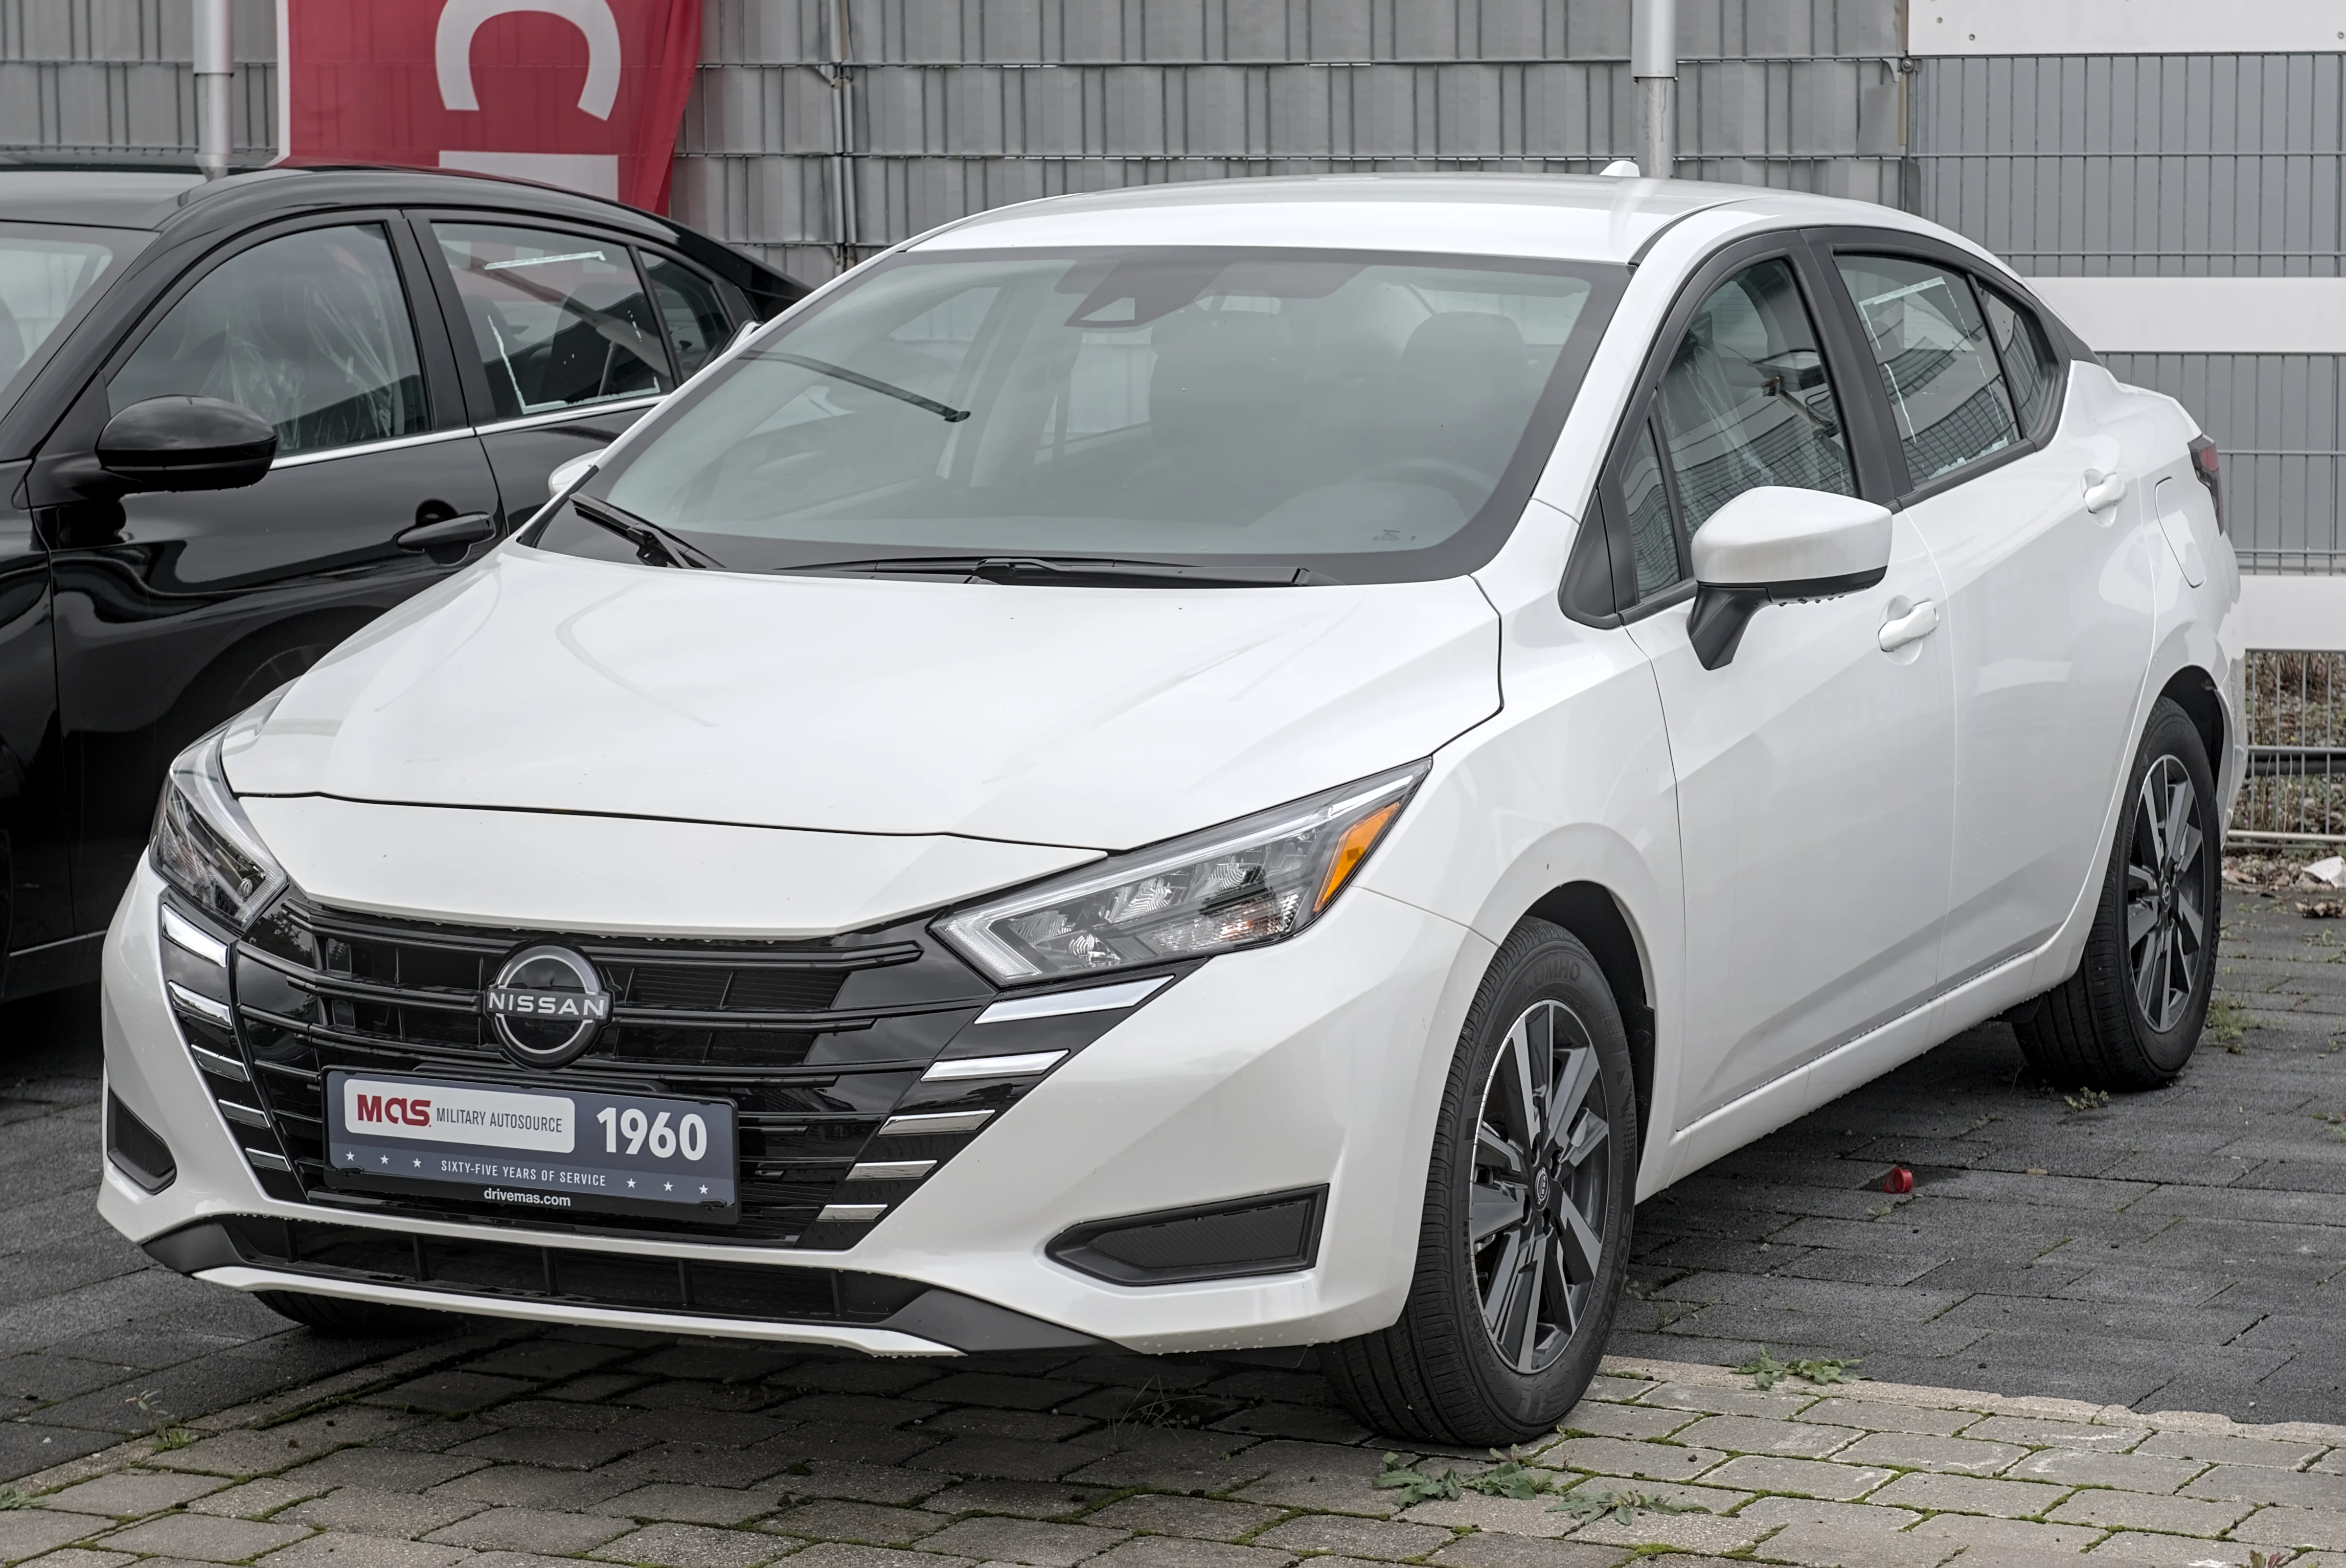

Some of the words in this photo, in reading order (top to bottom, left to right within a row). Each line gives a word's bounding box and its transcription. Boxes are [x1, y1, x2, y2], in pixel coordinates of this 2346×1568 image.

[2206, 890, 2221, 994] KUMHO
[1522, 958, 1581, 997] KUMHO
[489, 992, 605, 1016] NISSAN
[437, 1107, 486, 1126] MILITARY
[490, 1112, 563, 1133] AUTOSOURCE
[597, 1107, 708, 1161] 1960
[441, 1160, 498, 1176] SIXTY-FIVE
[503, 1166, 536, 1180] YEARS
[541, 1170, 555, 1181] OF
[560, 1171, 606, 1186] SERVICE
[484, 1188, 571, 1207] drivemas.com
[1598, 1212, 1632, 1339] SOLUS
